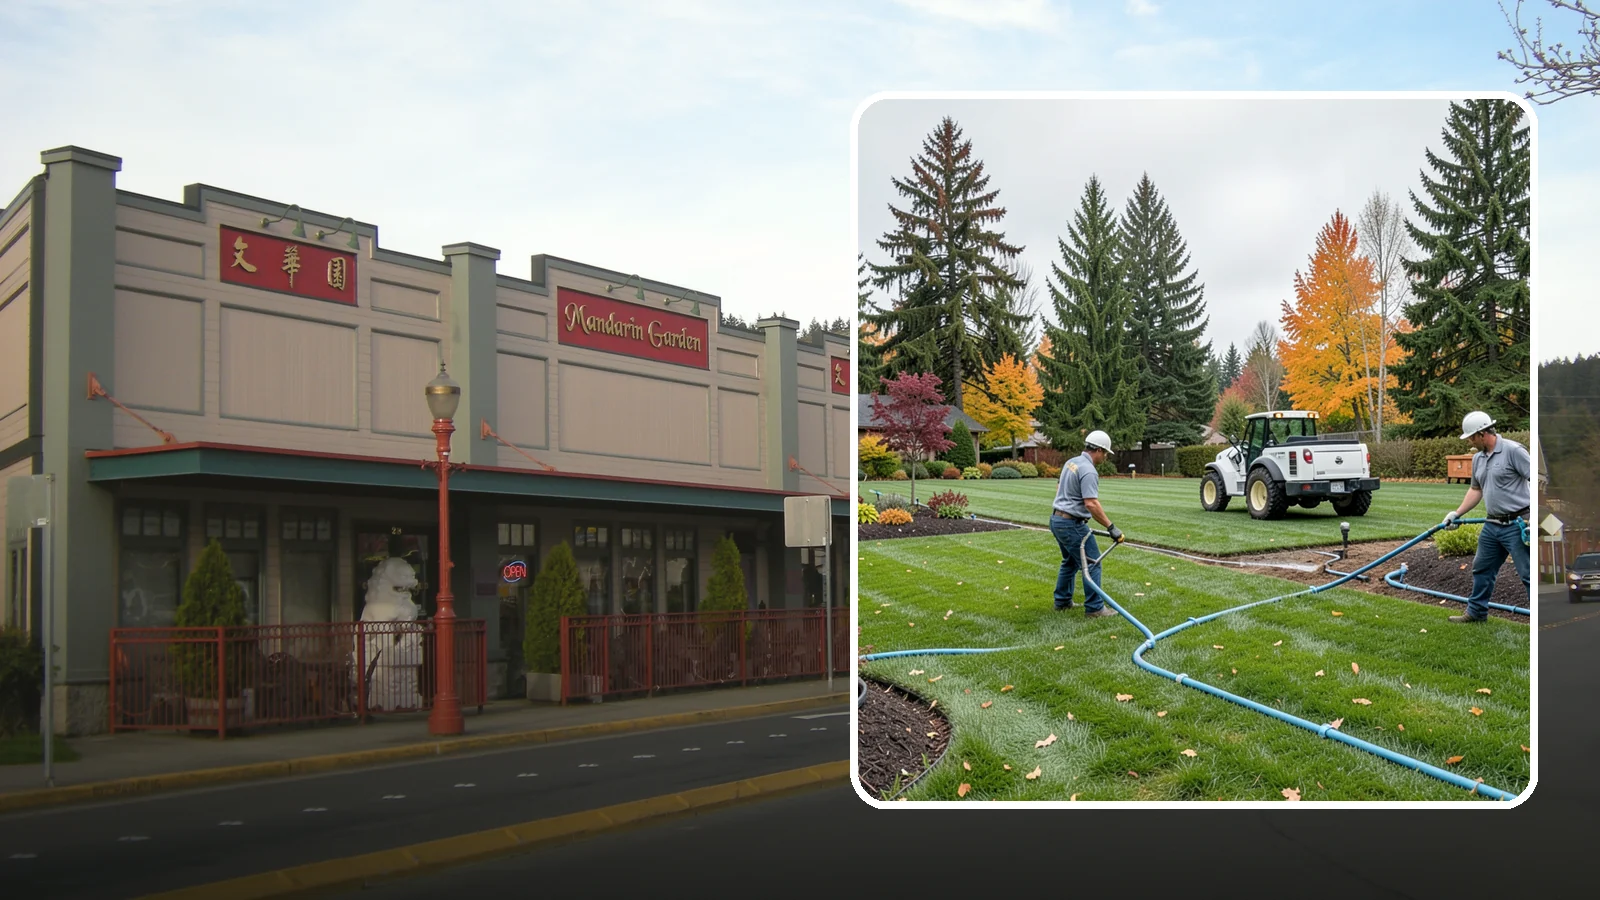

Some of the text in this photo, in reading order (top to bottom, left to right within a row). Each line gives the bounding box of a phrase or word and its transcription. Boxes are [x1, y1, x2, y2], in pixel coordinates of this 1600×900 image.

[230, 236, 346, 291] 文華園
[565, 302, 701, 352] Mandarin Garden
[834, 363, 846, 386] 文
[503, 565, 527, 578] OPEN
